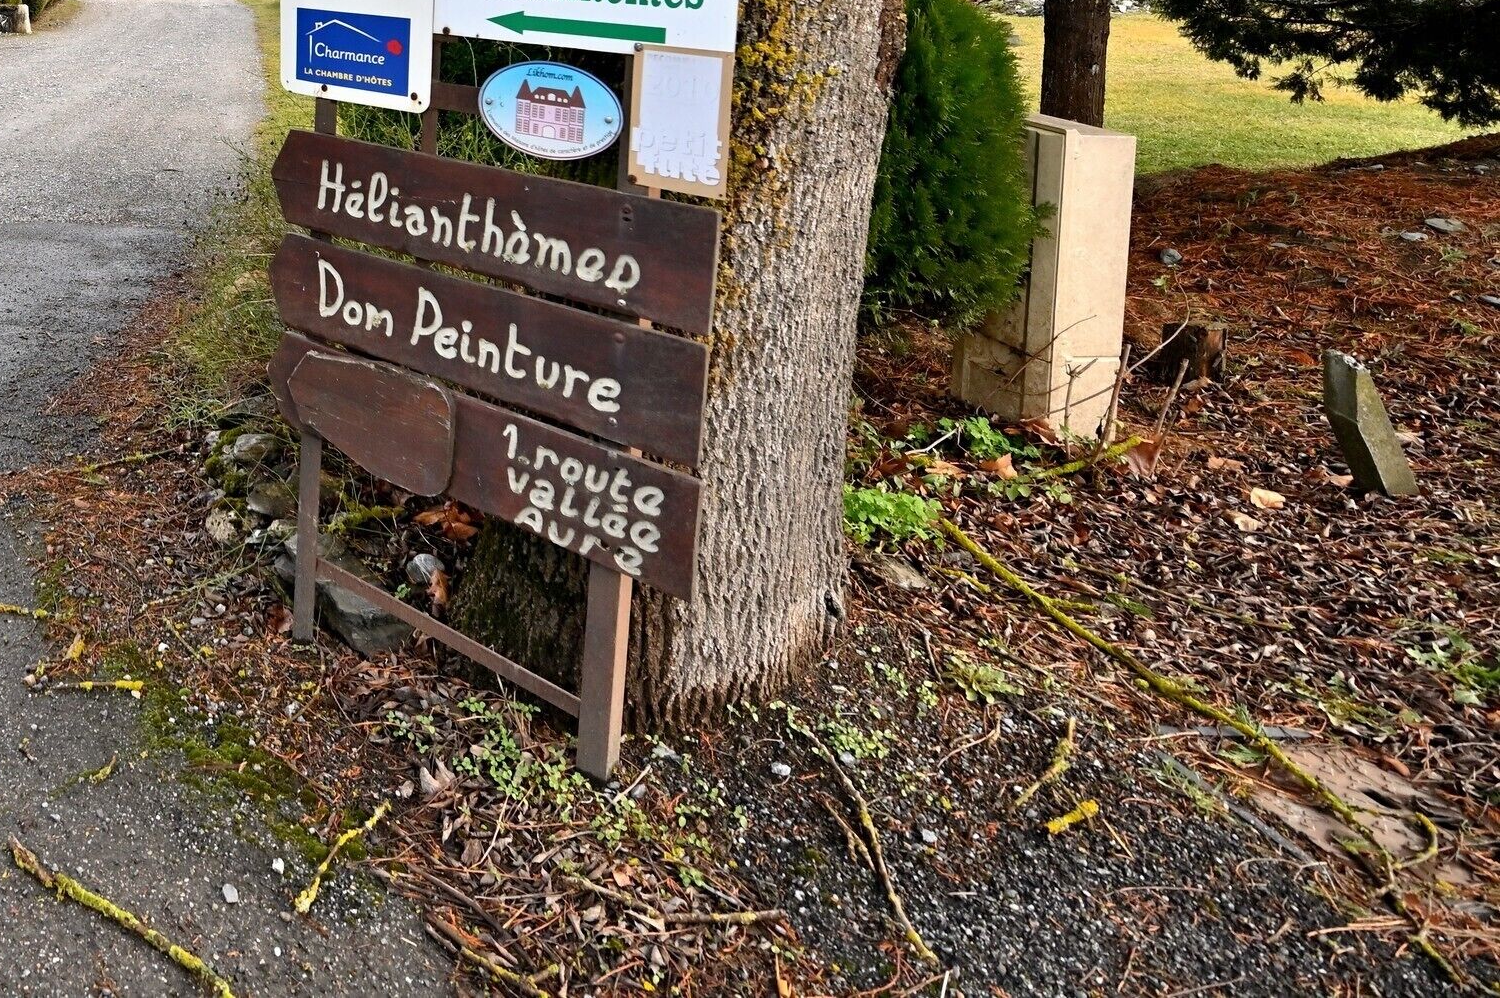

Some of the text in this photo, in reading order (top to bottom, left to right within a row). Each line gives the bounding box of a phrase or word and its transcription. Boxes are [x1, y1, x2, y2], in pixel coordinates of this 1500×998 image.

[304, 67, 393, 87] LA CHAMBRE D'HÔTES
[314, 42, 385, 65] Charmance
[410, 286, 622, 413] Peinture
[533, 445, 665, 516] route
